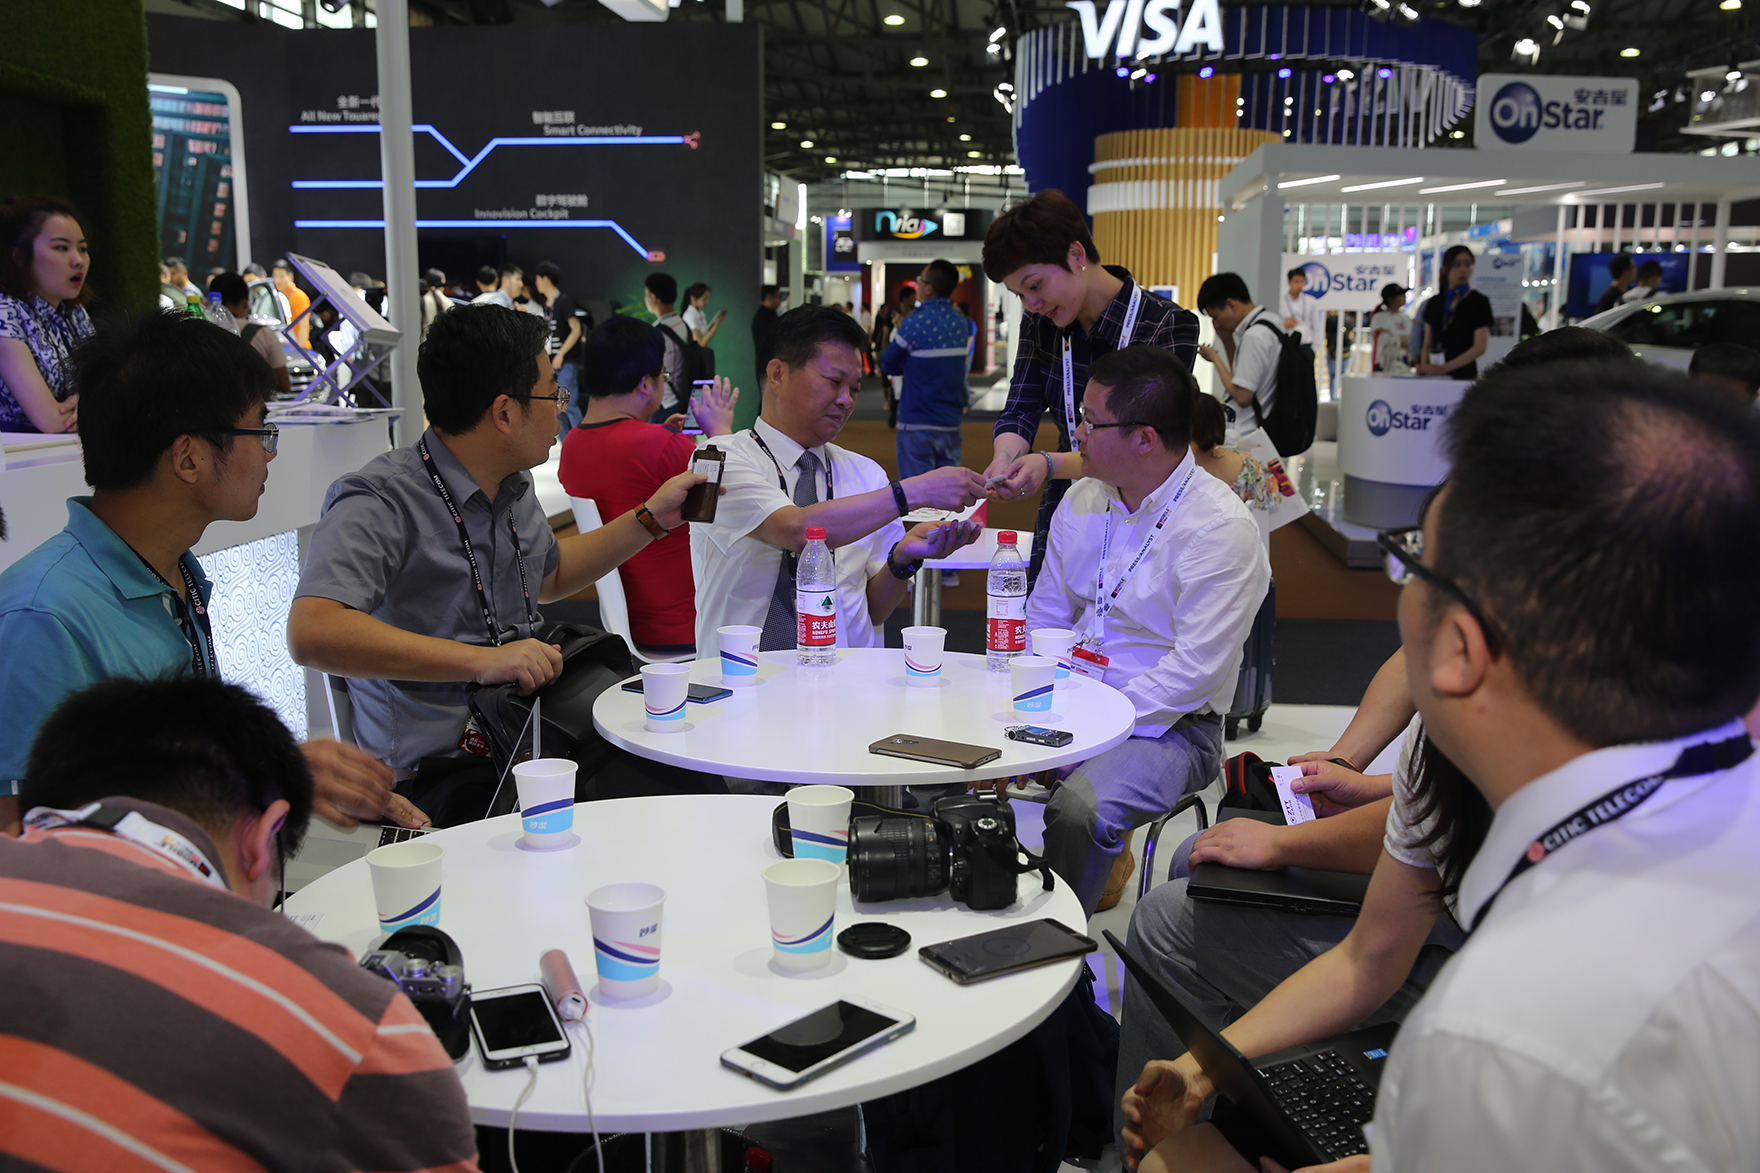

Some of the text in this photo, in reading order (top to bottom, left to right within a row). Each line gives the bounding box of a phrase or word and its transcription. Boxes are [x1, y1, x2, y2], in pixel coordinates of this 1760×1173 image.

[1065, 0, 1225, 58] VISA
[1573, 88, 1629, 105] 安吉星
[301, 110, 316, 122] All
[317, 110, 341, 122] New
[1491, 97, 1604, 133] OnStar
[543, 124, 643, 137] Smart Connectivity
[1367, 406, 1431, 431] OnStar
[1128, 534, 1155, 572] PRESS/ANALYST
[179, 560, 202, 606] CITIC TELECO
[812, 620, 836, 630] 农夫山
[1543, 814, 1587, 851] CITIC
